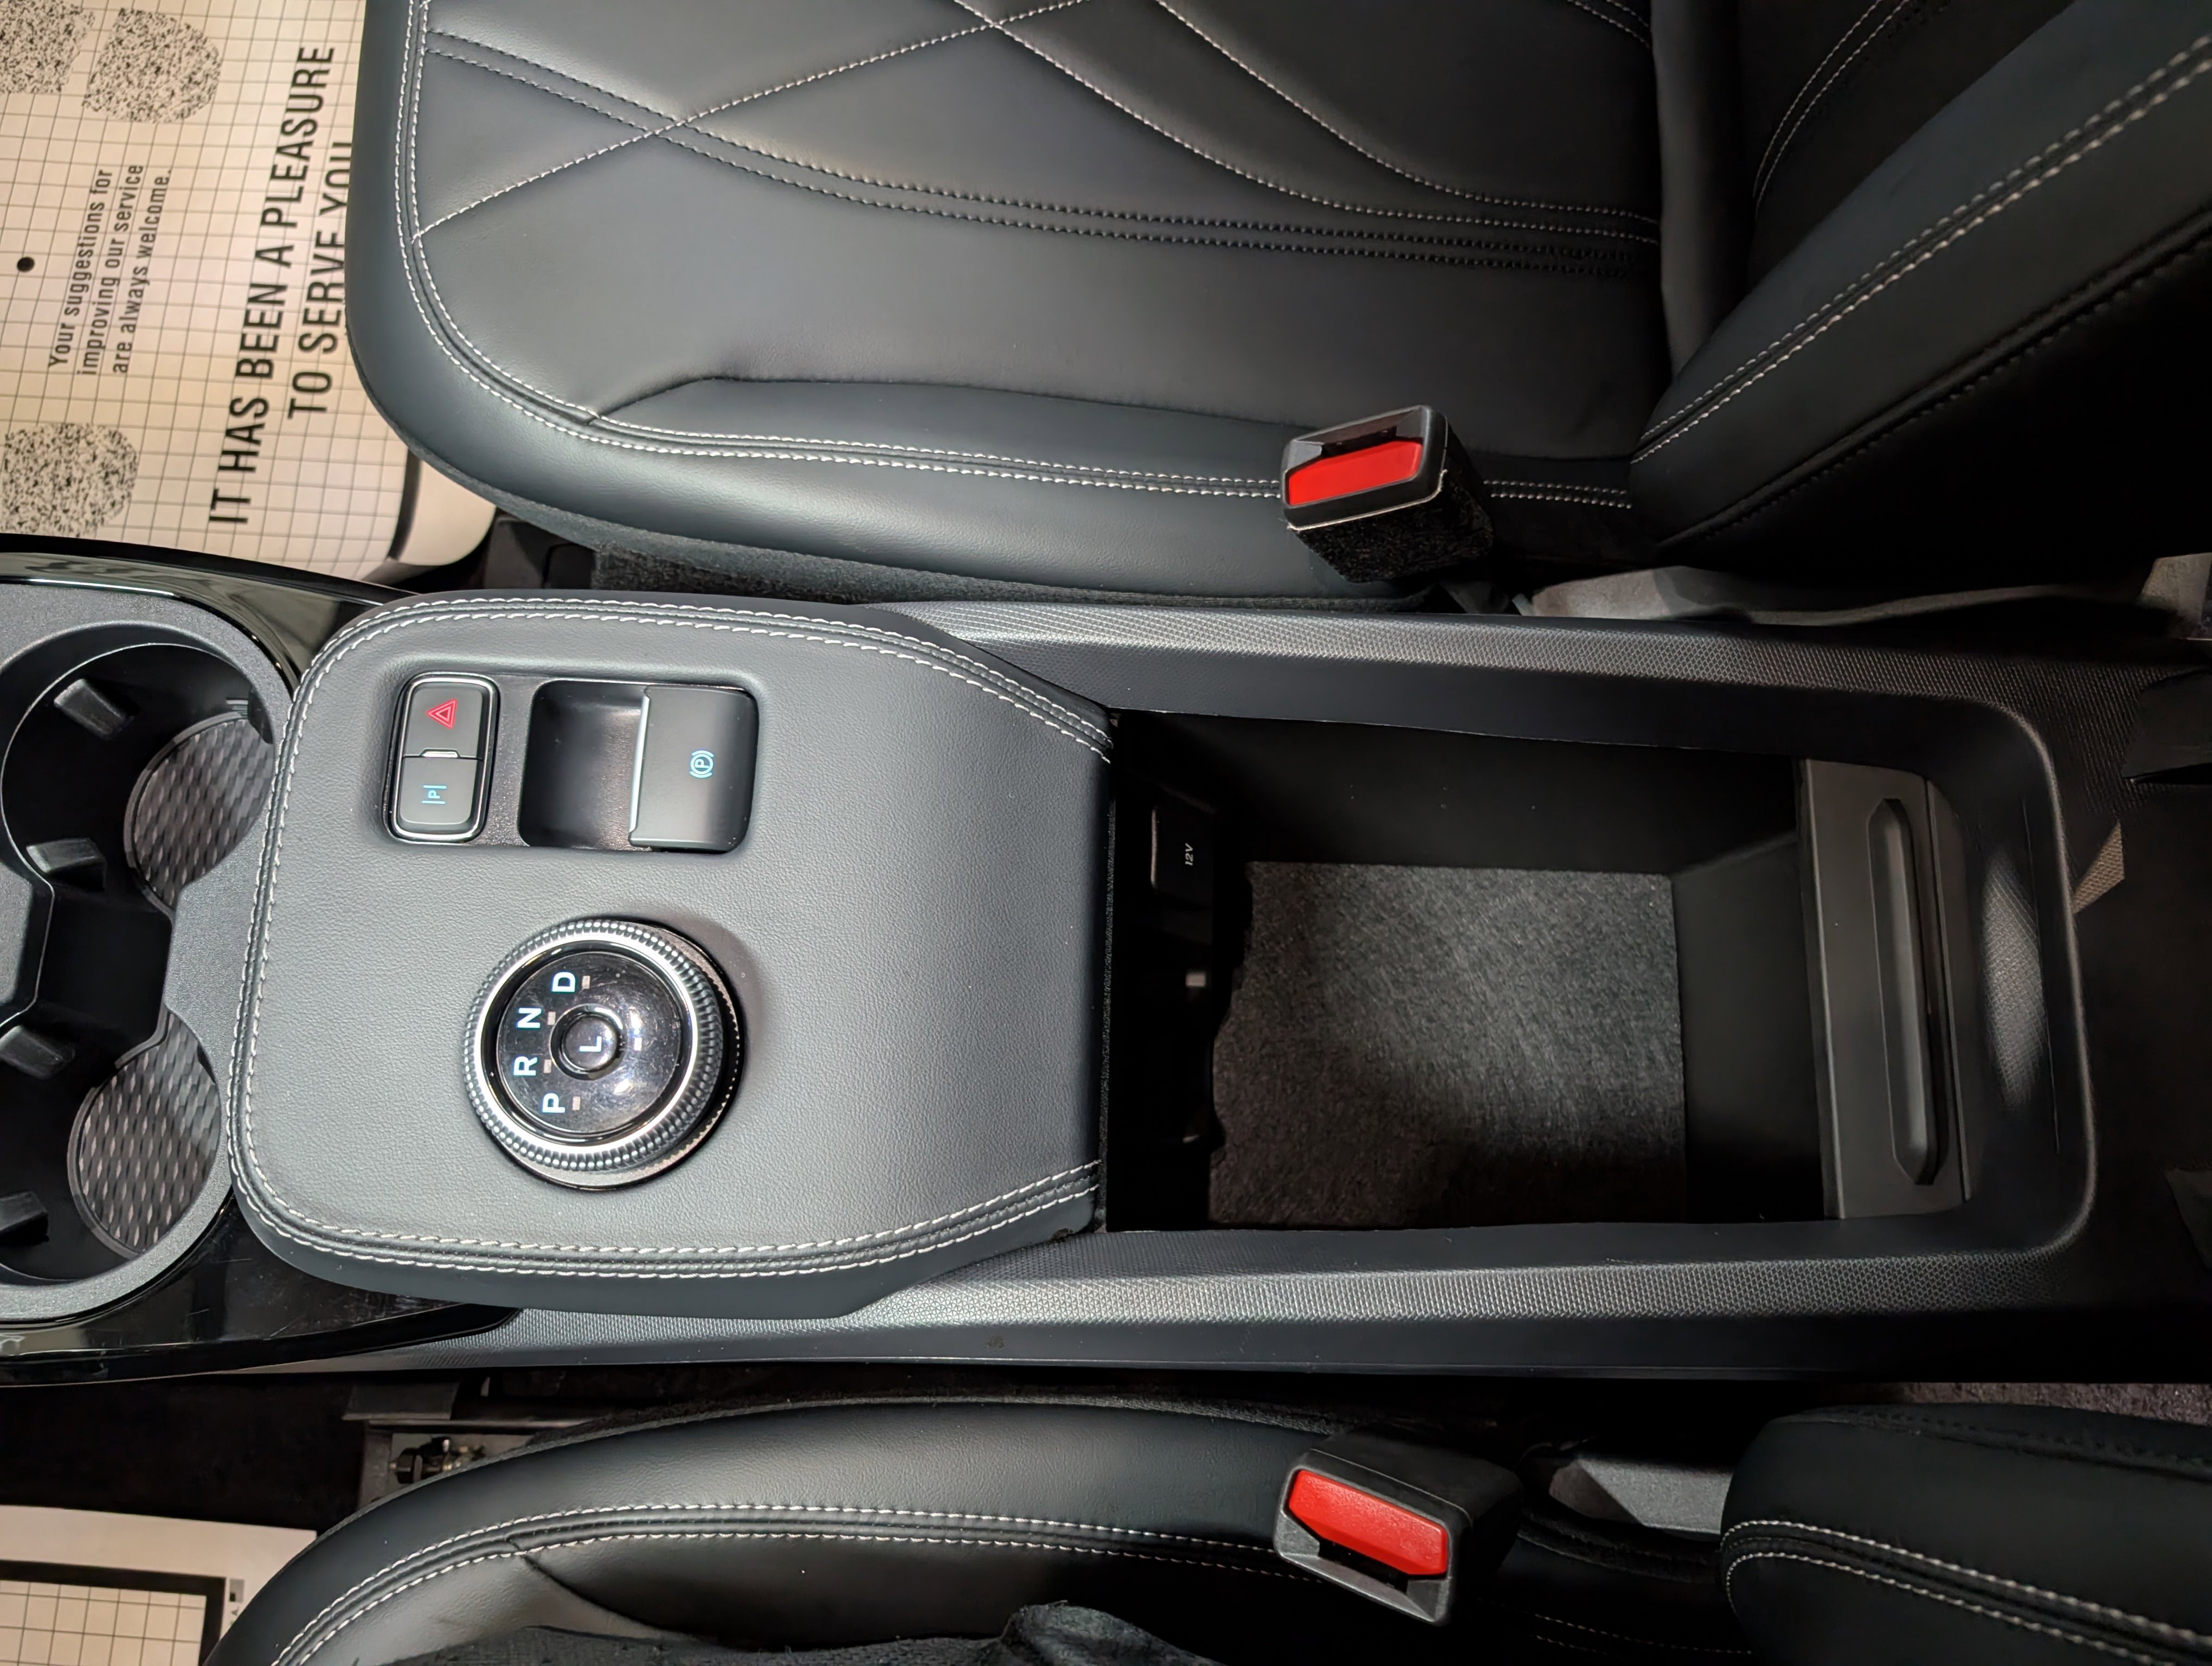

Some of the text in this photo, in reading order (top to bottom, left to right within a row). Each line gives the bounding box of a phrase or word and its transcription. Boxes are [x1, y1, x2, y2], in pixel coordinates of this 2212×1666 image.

[48, 169, 112, 368] Your suggestions for
[76, 165, 143, 375] improving our service
[113, 169, 172, 374] are always welcome.
[209, 47, 335, 524] IT HAS BEEN A PLEASURE
[298, 230, 345, 354] SERVE
[287, 371, 333, 420] TO
[1185, 843, 1194, 866] 12V
[514, 972, 576, 1113] P R N D
[579, 1036, 602, 1052] L
